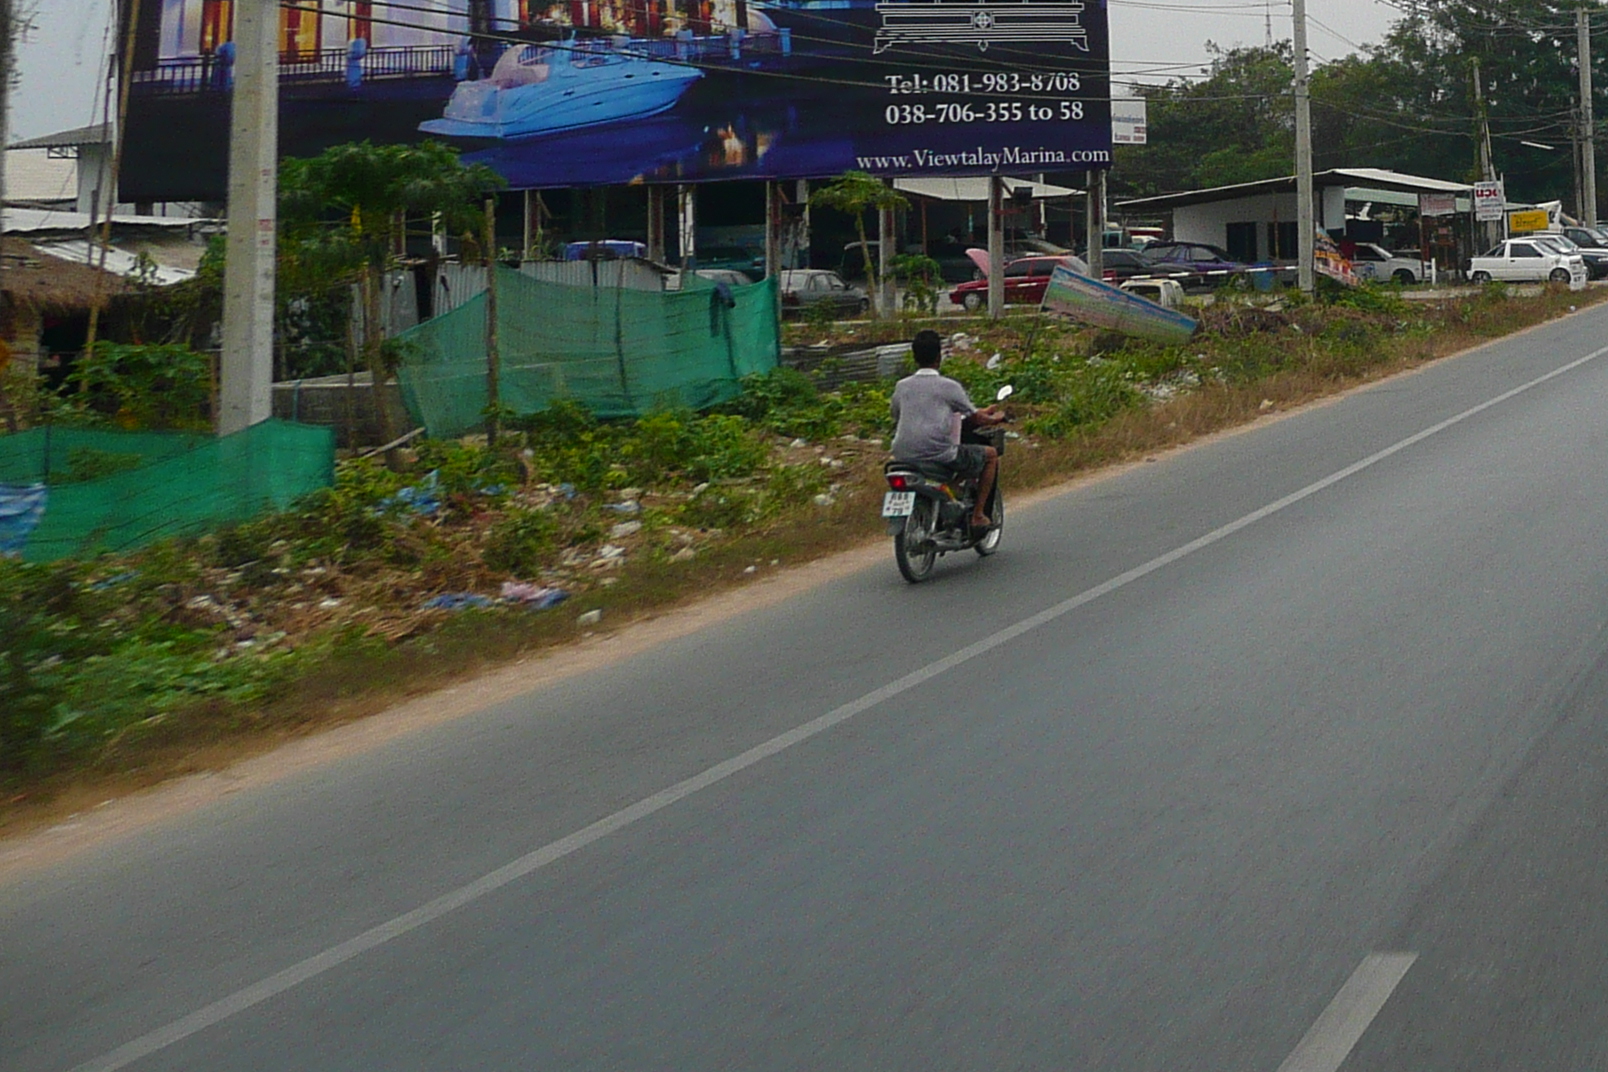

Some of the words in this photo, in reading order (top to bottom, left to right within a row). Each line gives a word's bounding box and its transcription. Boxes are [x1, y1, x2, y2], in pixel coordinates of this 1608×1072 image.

[884, 73, 928, 95] Tel:
[933, 72, 1081, 94] 081-983-8708
[885, 102, 1023, 125] 038-706-355
[1029, 103, 1053, 122] to
[1060, 101, 1084, 121] 58
